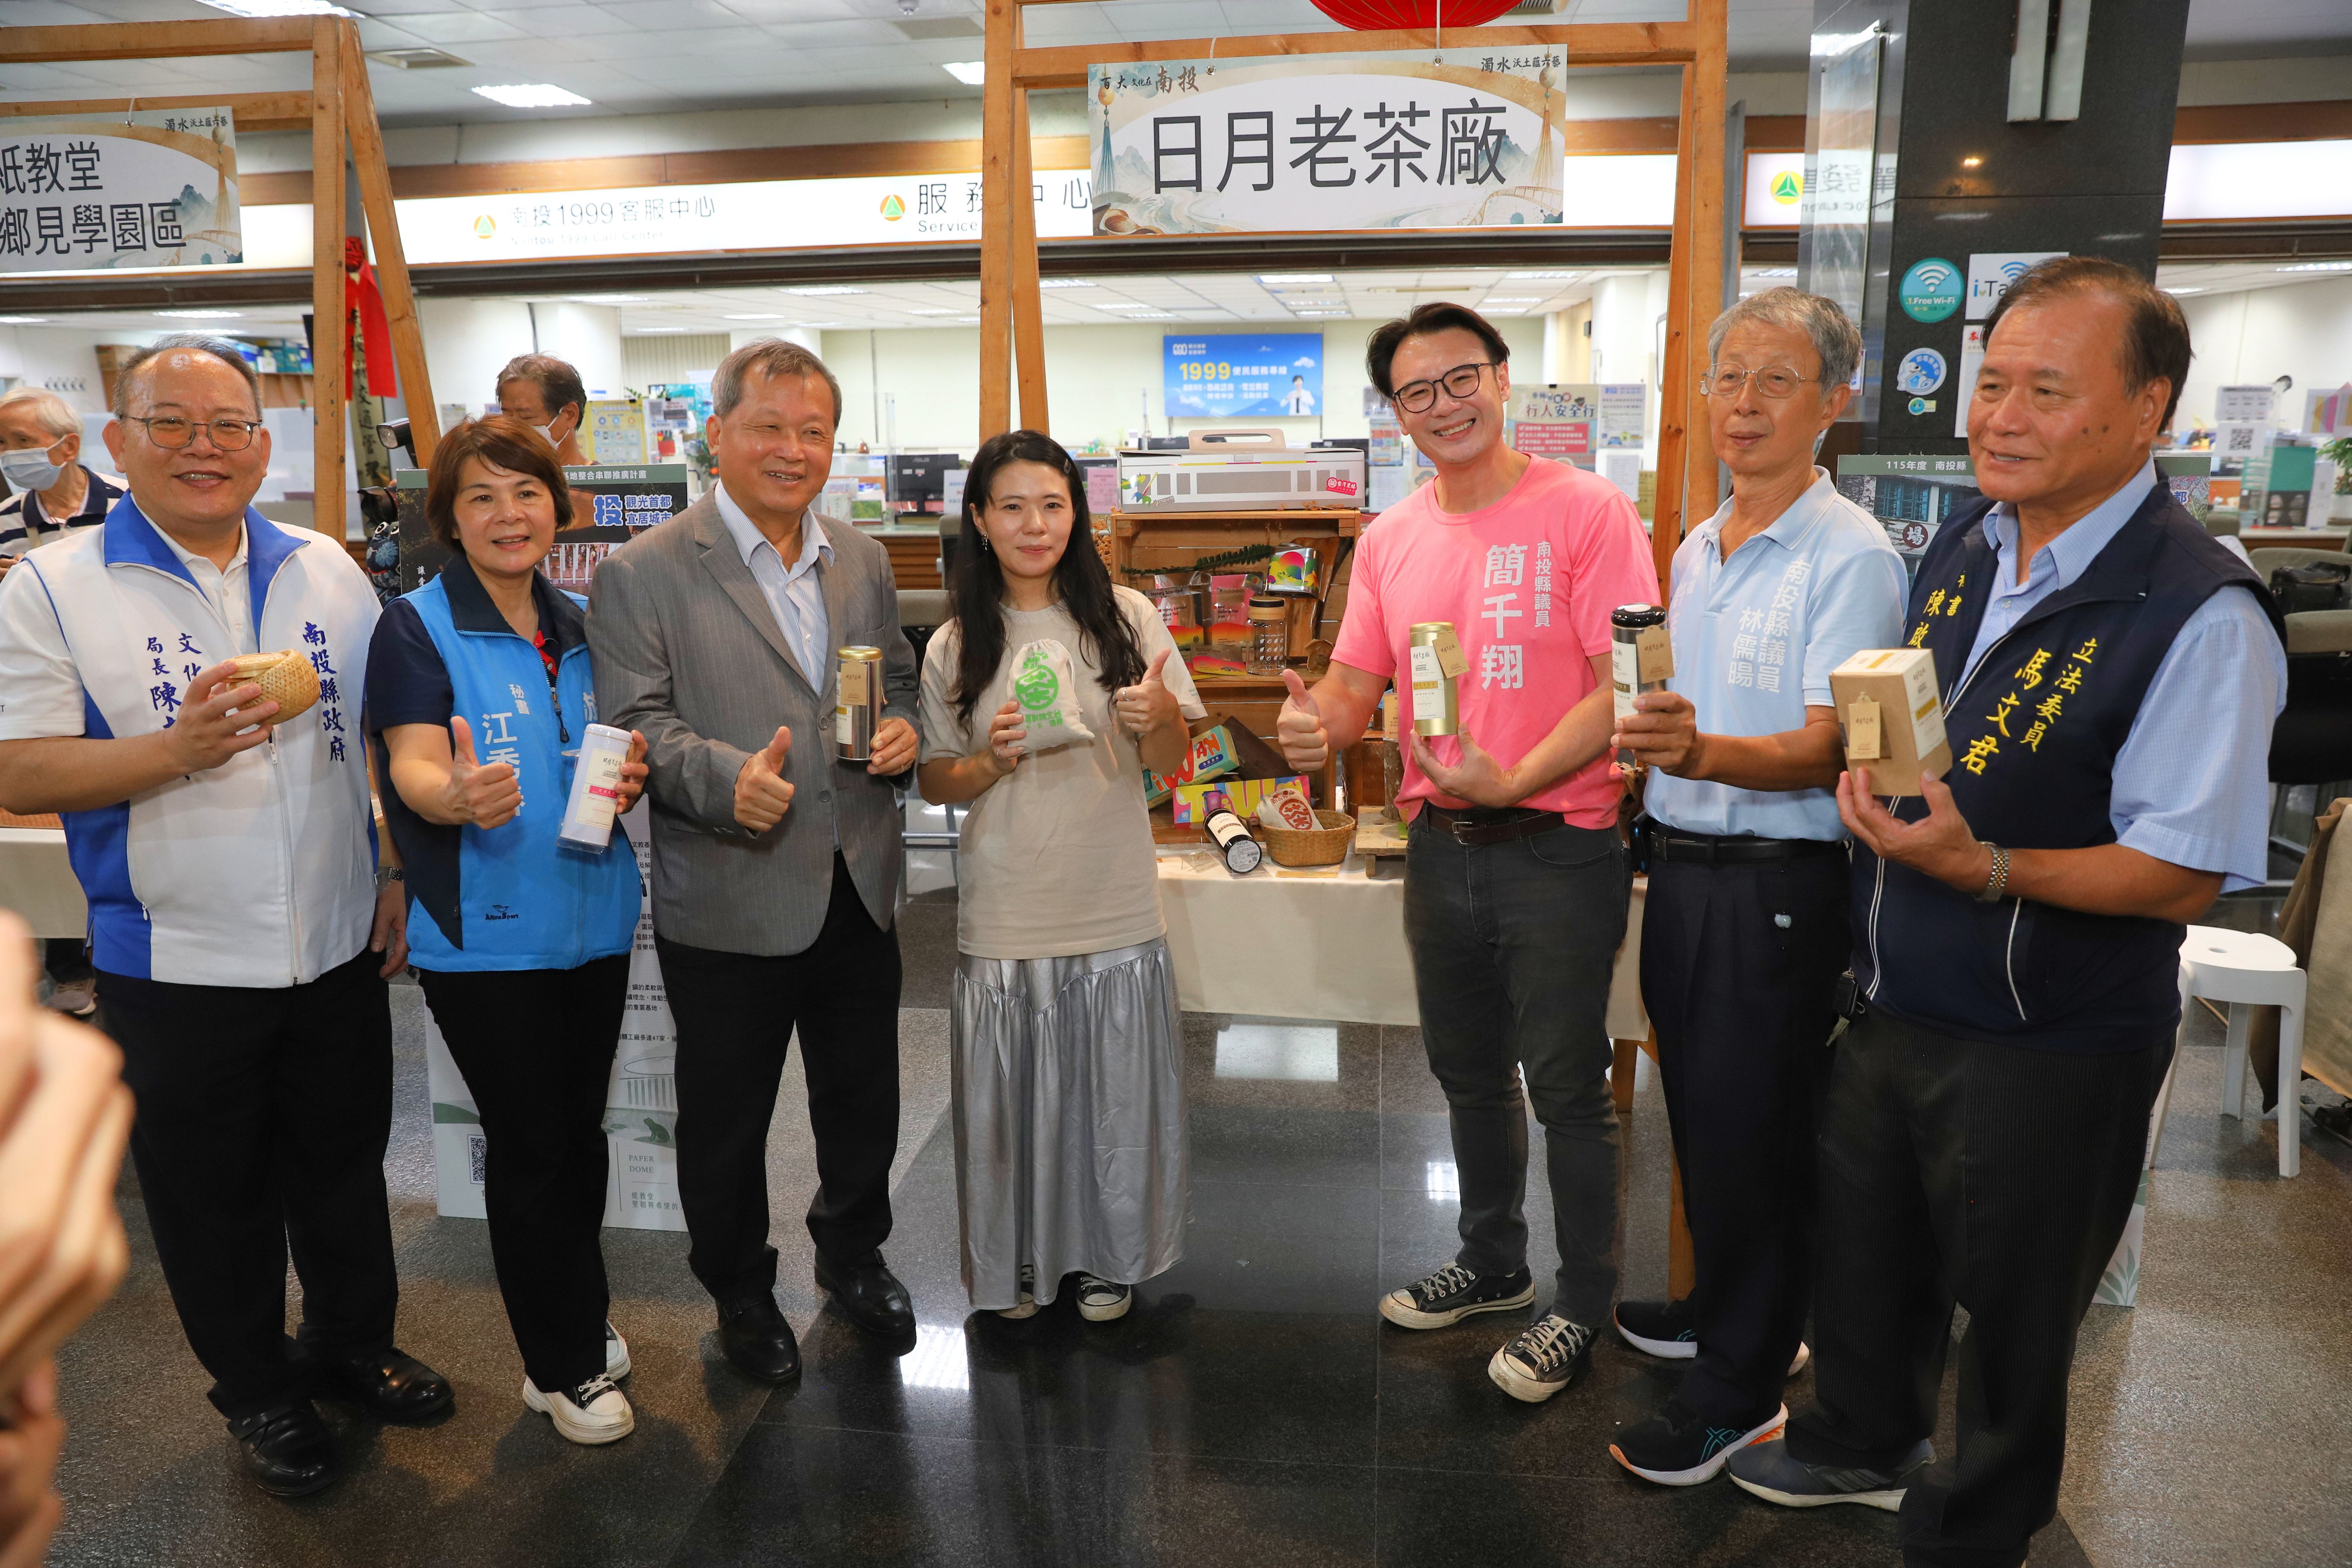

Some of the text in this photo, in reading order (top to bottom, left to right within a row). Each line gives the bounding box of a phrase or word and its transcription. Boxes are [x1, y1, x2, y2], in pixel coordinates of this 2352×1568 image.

[1152, 98, 1507, 195] 日月老茶廠
[509, 196, 715, 227] 南投1999客服中心
[561, 234, 587, 244] 1999
[623, 231, 663, 240] Center
[918, 220, 978, 232] Service
[1933, 296, 1955, 304] Wi-Fi
[1180, 362, 1231, 380] 1999
[1527, 404, 1595, 418] 行人安全行
[1886, 461, 1967, 471] 115年度 南投縣
[625, 496, 672, 508] 觀光首都
[626, 512, 672, 525] 宜居城市
[1534, 540, 1552, 628] 南投縣議員
[1481, 543, 1528, 690] 簡千翔
[1756, 559, 1812, 693] 南投縣議員
[302, 621, 346, 762] 南投縣政府
[509, 684, 530, 715] 秘書
[2020, 637, 2098, 753] 立法委員
[1960, 647, 2052, 776] 馬文君
[632, 1192, 654, 1200] 紙教堂
